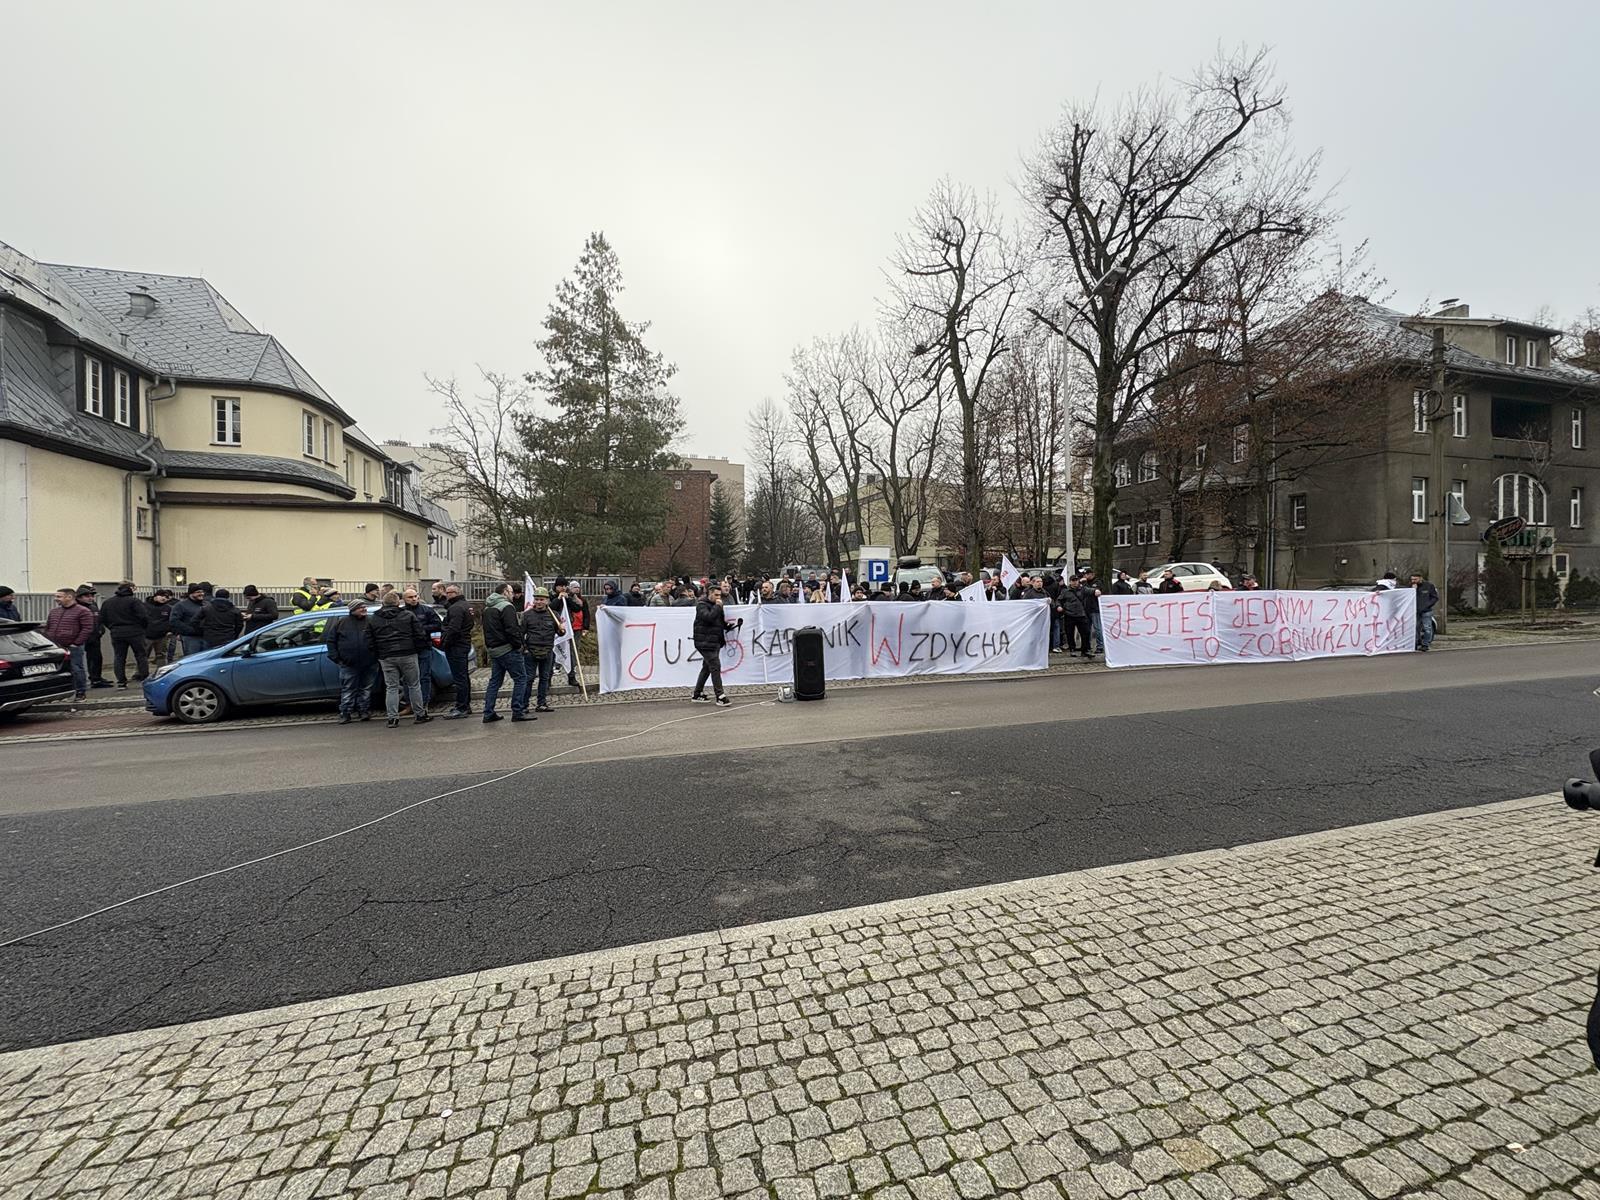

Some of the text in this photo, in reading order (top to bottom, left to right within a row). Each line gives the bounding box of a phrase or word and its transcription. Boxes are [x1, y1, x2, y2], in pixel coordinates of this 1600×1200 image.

[872, 562, 885, 580] P
[1106, 595, 1215, 640] JESTEŚ
[1231, 597, 1314, 629] JEDNYM
[1321, 598, 1339, 621] Z
[870, 612, 1010, 667] WZDYCHA
[1184, 636, 1221, 659] TO
